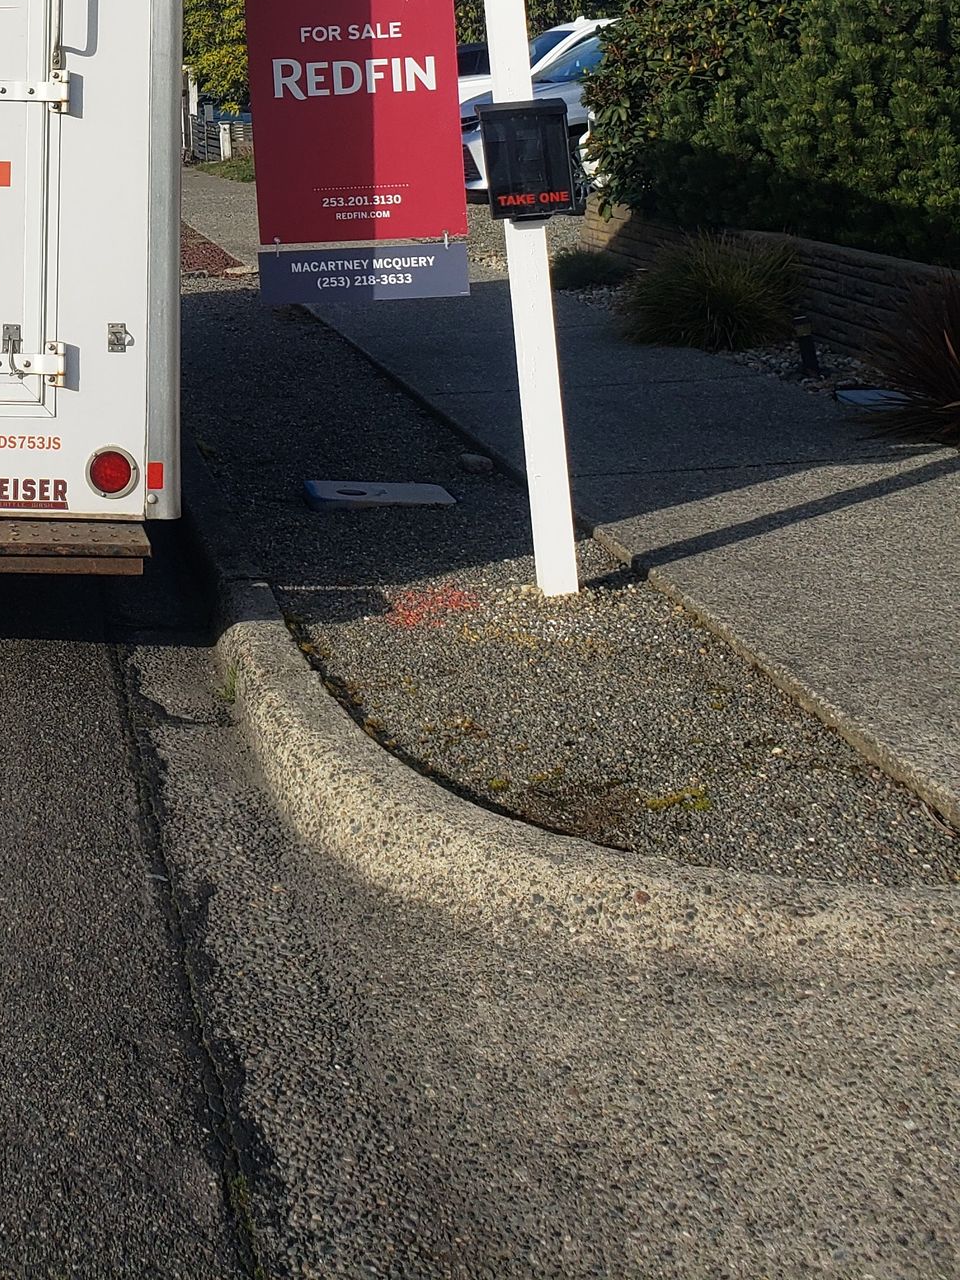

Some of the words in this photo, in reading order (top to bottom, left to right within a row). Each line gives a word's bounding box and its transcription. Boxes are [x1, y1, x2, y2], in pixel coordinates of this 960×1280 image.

[300, 25, 342, 42] FOR
[348, 22, 402, 39] SALE
[271, 56, 437, 101] REDFIN
[322, 195, 402, 208] 253.201.3130
[498, 194, 536, 206] TAKE
[540, 191, 570, 203] ONE
[335, 210, 391, 221] REDFIN.COM
[291, 259, 369, 273] MACARTNEY
[373, 256, 435, 269] MCQUERY
[317, 276, 351, 290] (253)
[354, 273, 413, 286] 218-3633
